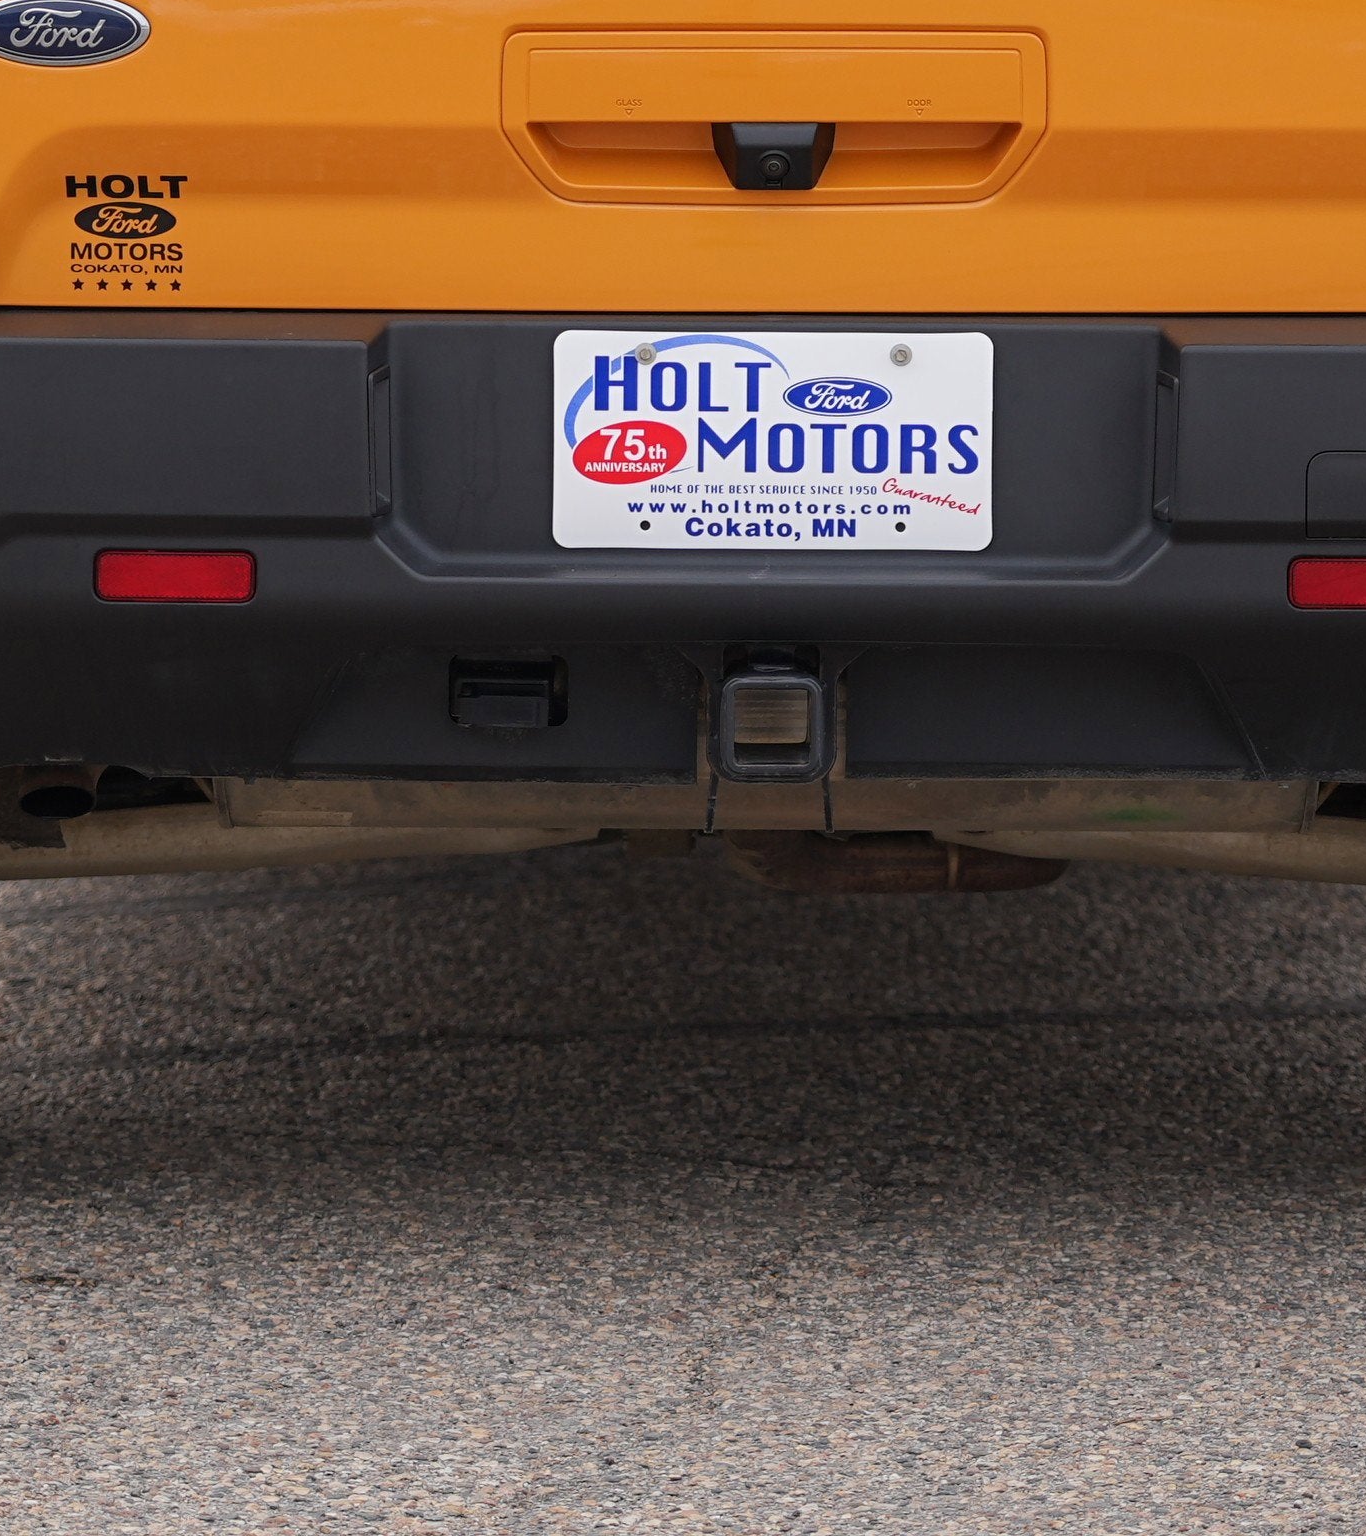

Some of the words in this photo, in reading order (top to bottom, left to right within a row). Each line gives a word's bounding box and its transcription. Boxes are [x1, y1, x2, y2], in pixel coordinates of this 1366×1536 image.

[9, 7, 107, 48] Ford
[615, 98, 643, 107] GLASS
[906, 99, 932, 107] DOOR
[65, 174, 188, 199] HOLT
[91, 205, 159, 234] Ford
[70, 242, 183, 261] MOTORS
[70, 264, 148, 276] COKATO,
[154, 265, 183, 274] MN
[594, 355, 772, 413] HOLT
[804, 382, 871, 410] Ford
[599, 428, 667, 461] 75th
[698, 417, 979, 474] MOTORS
[584, 461, 666, 473] ANNIVERSARY
[650, 484, 682, 494] HOME
[687, 484, 700, 494] OF
[704, 484, 724, 494] THE
[729, 484, 755, 494] BEST
[759, 484, 806, 495] SERVICE
[810, 485, 844, 495] SINCE
[849, 485, 877, 495] 1950
[882, 477, 982, 515] Guaranteed
[627, 500, 911, 515] www.holtmotors.com
[685, 517, 801, 541] Cokato,
[812, 518, 856, 537] MN
